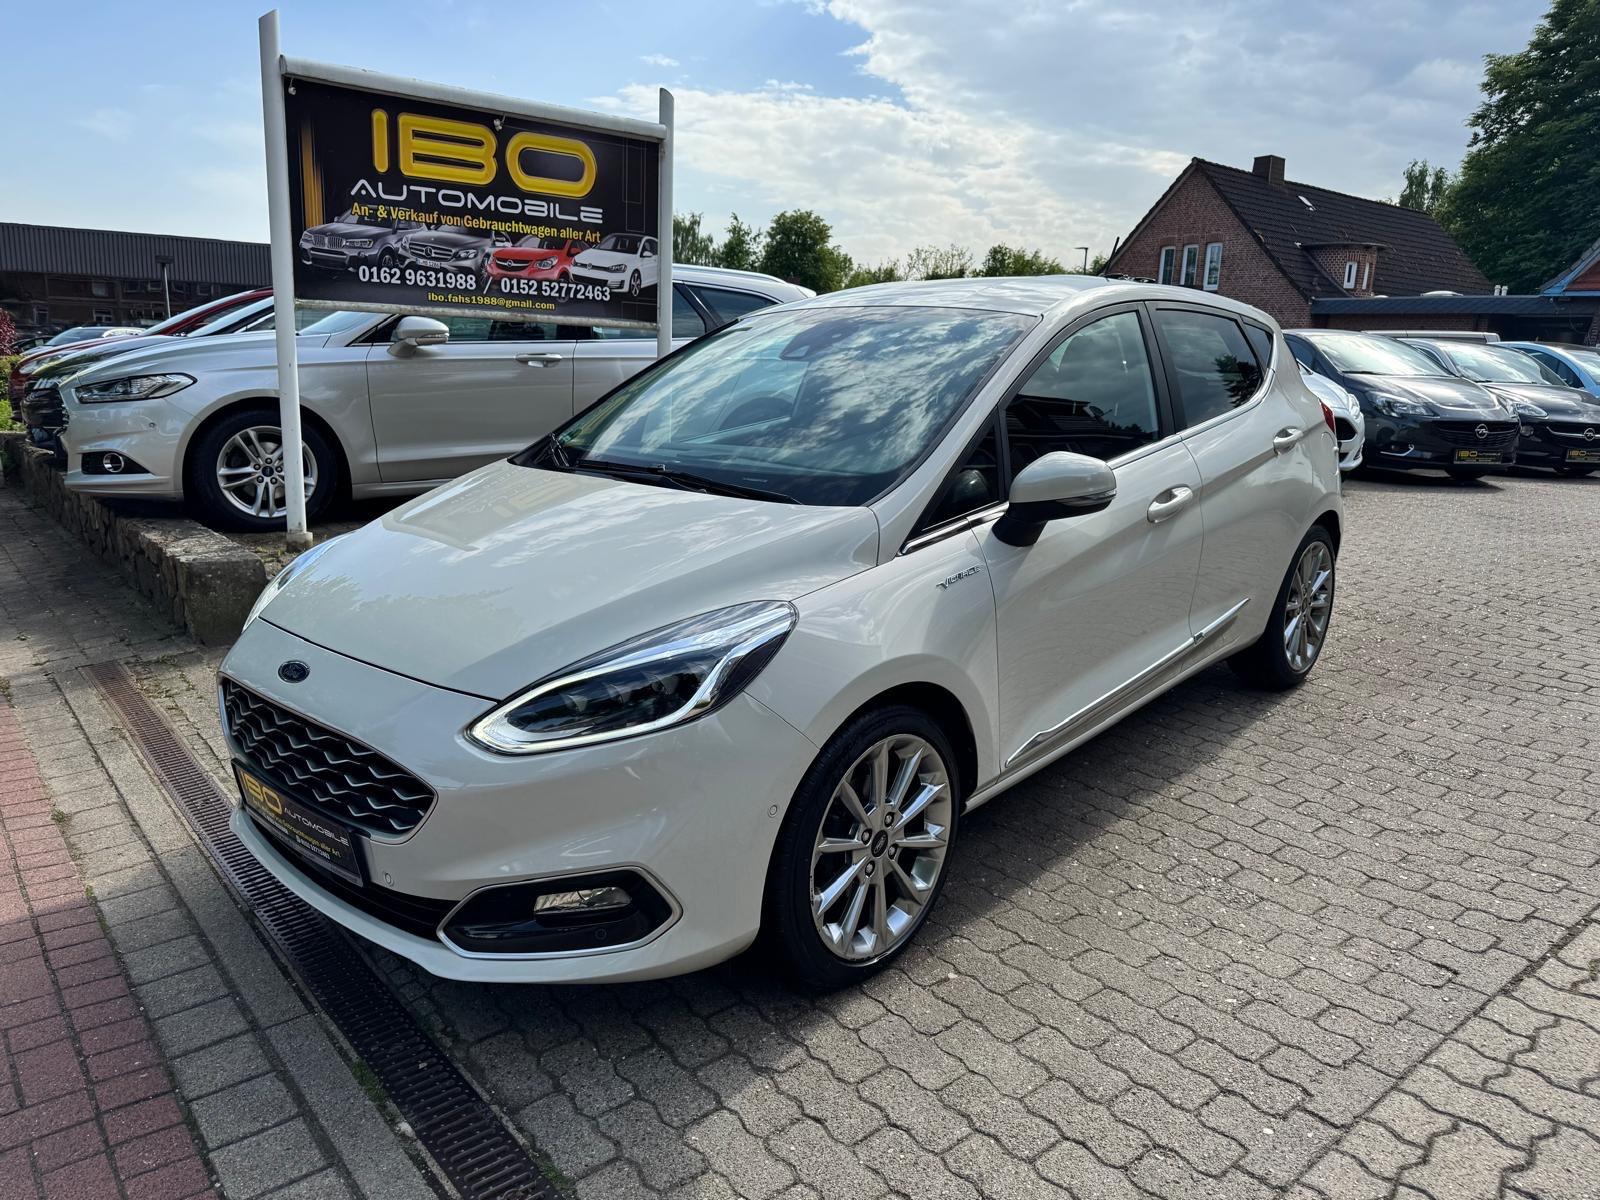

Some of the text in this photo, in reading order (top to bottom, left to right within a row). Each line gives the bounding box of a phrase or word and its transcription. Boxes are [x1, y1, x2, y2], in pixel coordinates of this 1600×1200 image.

[371, 108, 598, 199] IBO
[350, 179, 603, 224] AUTOMOBILE
[351, 202, 601, 243] An- & Verkauf von Gebrauchtwagen aller Art
[358, 265, 401, 285] 0162
[405, 269, 477, 290] 9631988
[501, 277, 538, 296] 0152
[541, 281, 611, 302] 52772463
[428, 292, 555, 310] ibo.fahs1988@gmail.com
